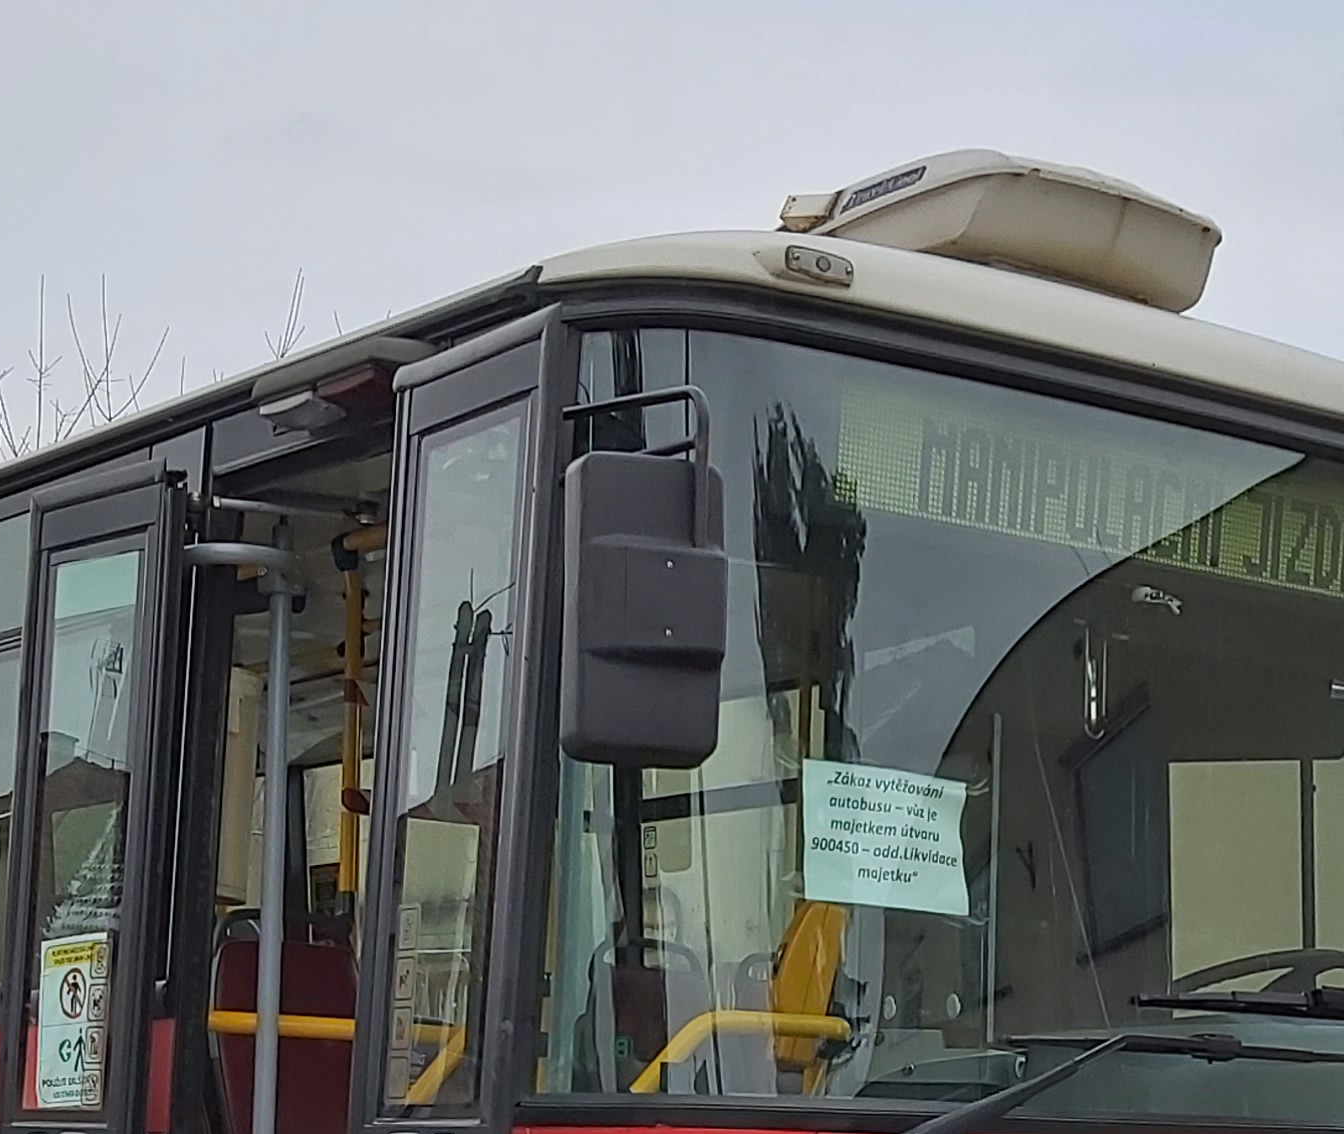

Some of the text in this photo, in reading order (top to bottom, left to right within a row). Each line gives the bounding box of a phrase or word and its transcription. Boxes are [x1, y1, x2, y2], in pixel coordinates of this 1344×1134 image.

[829, 795, 892, 813] autobusu
[906, 803, 925, 819] vůz
[926, 808, 938, 823] je
[830, 817, 940, 842] majetkem útvaru
[810, 836, 859, 855] 900450
